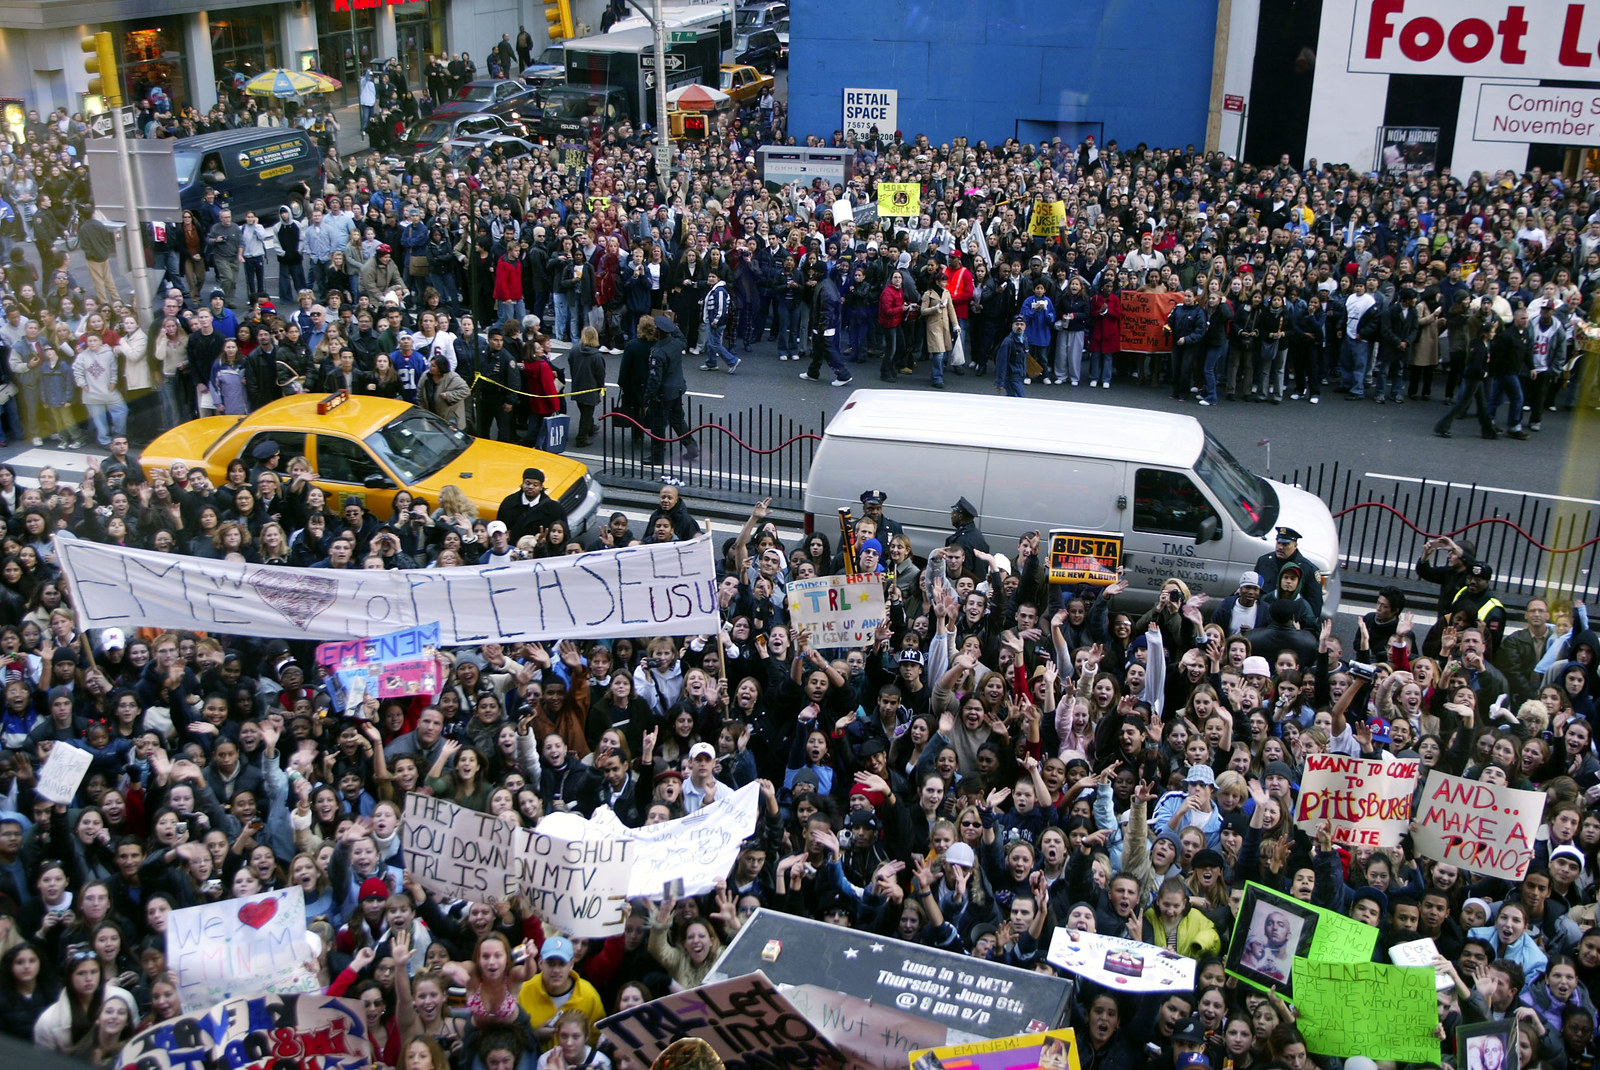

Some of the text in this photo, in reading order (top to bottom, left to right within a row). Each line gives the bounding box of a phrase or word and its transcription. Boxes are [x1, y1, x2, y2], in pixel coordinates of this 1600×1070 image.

[675, 32, 682, 42] 7
[1365, 0, 1600, 67] Foot L
[847, 92, 890, 106] RETAIL
[1508, 93, 1584, 118] Coming
[847, 106, 887, 120] SPACE
[1493, 115, 1595, 136] November
[1387, 130, 1438, 143] NOW HIRING
[1053, 537, 1118, 558] BUSTA
[1162, 542, 1197, 558] T.M.S.
[1150, 555, 1205, 570] 4 Jay Street
[1052, 570, 1066, 578] THE
[1087, 573, 1118, 582] ALBUM
[1154, 567, 1176, 578] York
[1193, 571, 1218, 583] 10013
[804, 587, 852, 613] TRL
[854, 632, 863, 641] U
[903, 649, 917, 659] NY
[1383, 725, 1390, 735] T
[1306, 755, 1420, 780] WANT TO COME
[1344, 775, 1364, 789] TO
[407, 792, 461, 828] THEY
[474, 813, 516, 846] TRY
[522, 828, 552, 856] TO
[562, 839, 635, 864] SHUT
[1422, 806, 1528, 849] MAKE A
[402, 820, 445, 855] YOU
[451, 836, 508, 871] DOWN
[403, 848, 447, 883] TRL
[451, 863, 488, 892] IS
[1318, 924, 1339, 943] SO
[1325, 912, 1364, 935] WITH
[901, 958, 1014, 994] tune in to MTV
[1294, 956, 1430, 989] EMINEM YOU
[1294, 975, 1326, 992] ARE
[1332, 980, 1362, 995] THE
[1363, 980, 1397, 998] MAN
[895, 992, 918, 1009] @
[919, 997, 932, 1010] 8
[932, 1001, 958, 1018] pm
[954, 987, 995, 1009] June
[995, 998, 1024, 1014] 6th
[1335, 993, 1360, 1007] ME
[1362, 995, 1409, 1012] WRONG
[1312, 1004, 1344, 1019] FAN
[952, 1037, 1021, 1057] EMINEM!
